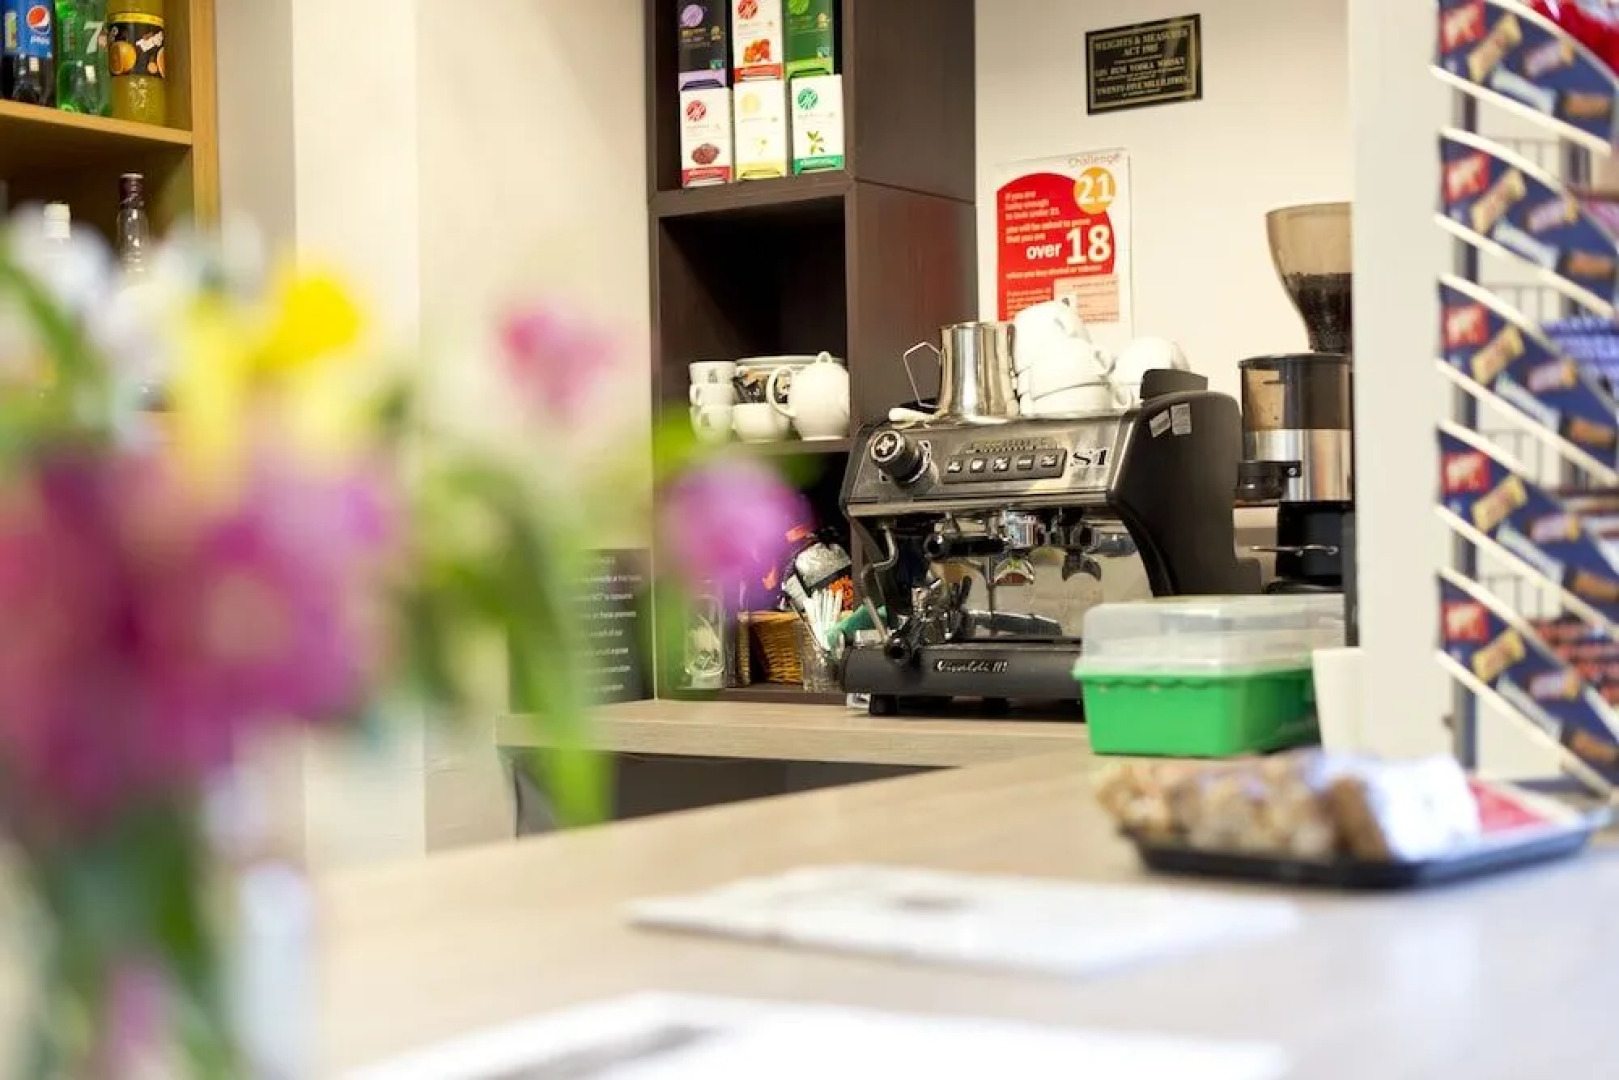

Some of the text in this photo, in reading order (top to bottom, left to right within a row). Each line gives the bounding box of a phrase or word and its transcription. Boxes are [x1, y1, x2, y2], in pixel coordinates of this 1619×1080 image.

[1123, 46, 1140, 56] ACT
[1068, 153, 1121, 167] Challenge
[1078, 173, 1115, 205] 21
[1026, 225, 1112, 265] over 18
[1070, 450, 1107, 467] S1
